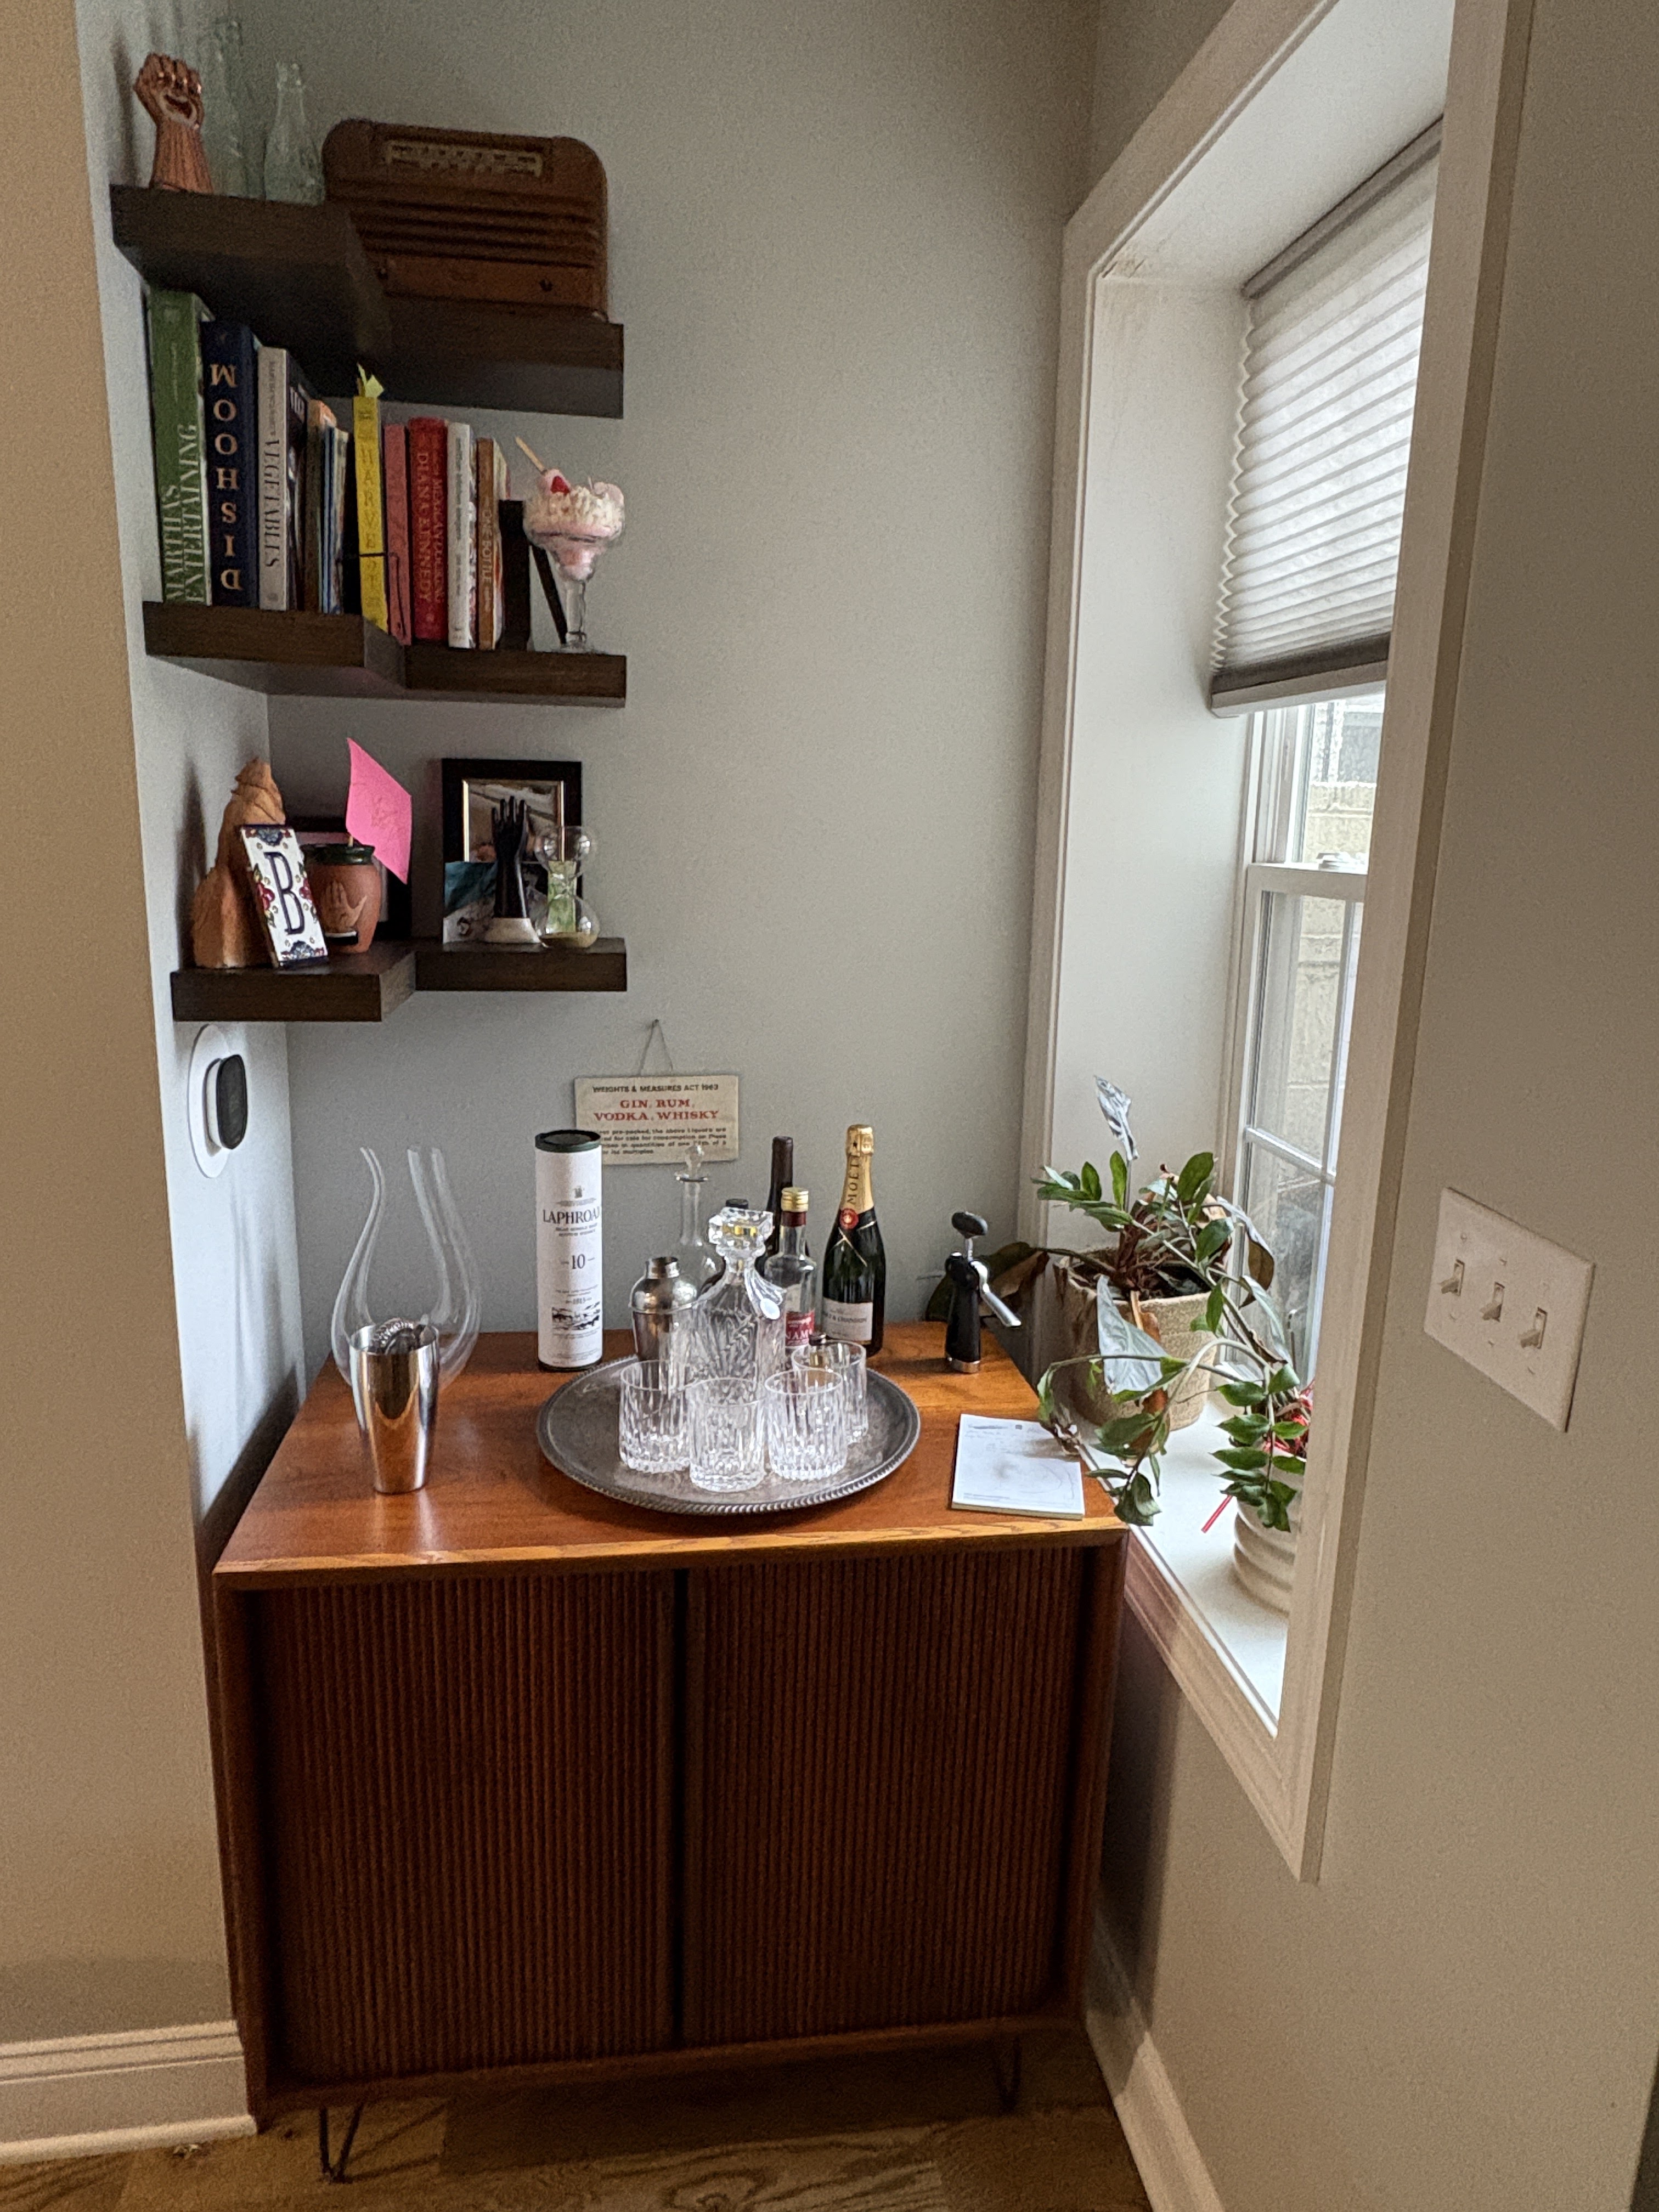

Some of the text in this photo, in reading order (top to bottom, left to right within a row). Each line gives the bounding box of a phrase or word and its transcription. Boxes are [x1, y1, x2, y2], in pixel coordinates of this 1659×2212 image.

[177, 424, 205, 602] ENTERTAINING
[263, 439, 281, 568] VEGETABLES
[416, 453, 432, 602] DIANA KENNEDY
[264, 851, 306, 935] B
[656, 1110, 719, 1120] WHISKY
[542, 1206, 600, 1225] LAPHROAI
[572, 1254, 585, 1269] 10
